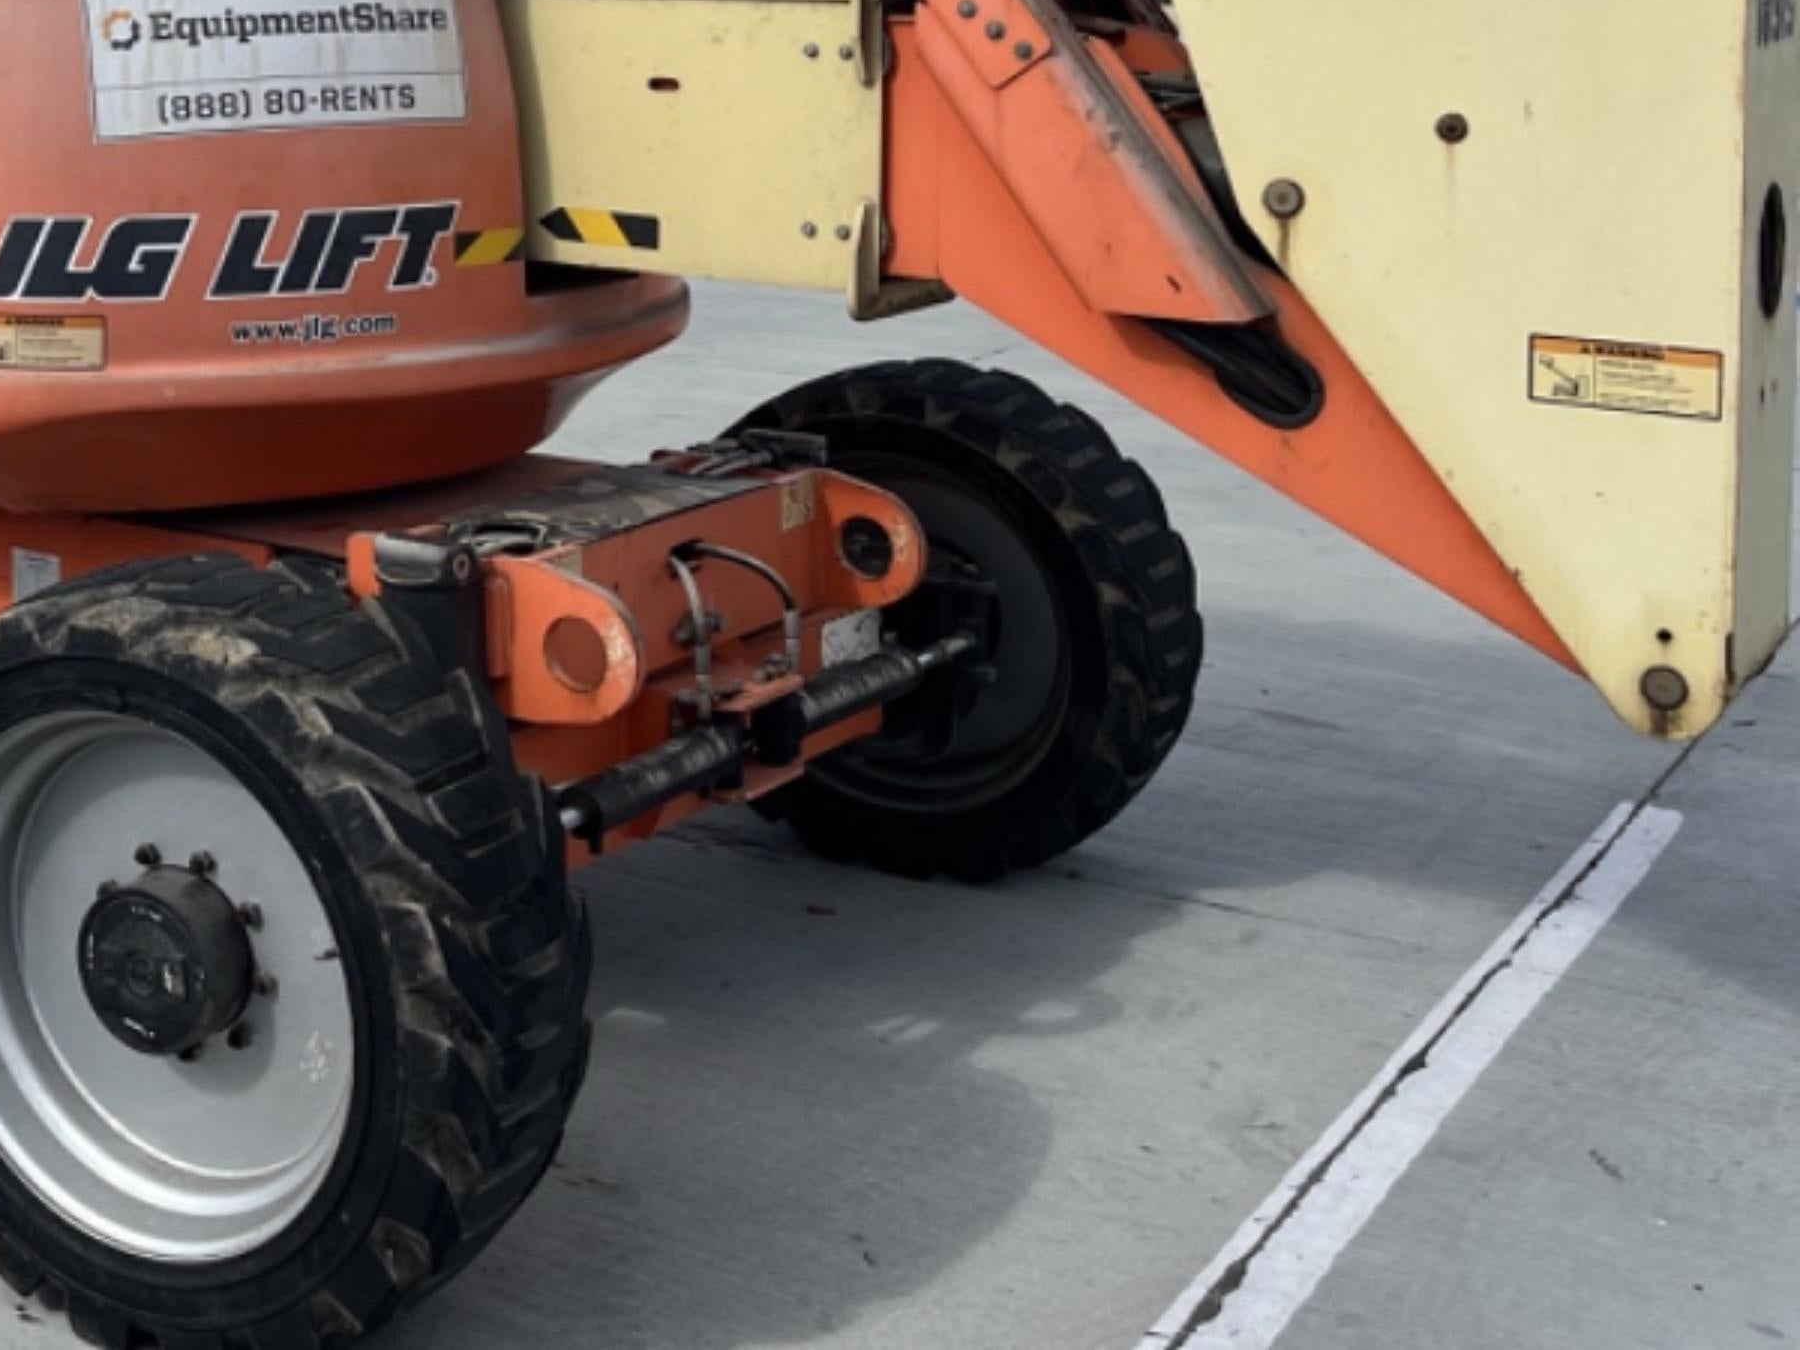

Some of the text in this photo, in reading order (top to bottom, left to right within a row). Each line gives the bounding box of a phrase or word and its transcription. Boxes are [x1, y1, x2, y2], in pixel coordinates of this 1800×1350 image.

[148, 2, 448, 47] EquipmentShare
[157, 83, 417, 125] (888) 80-RENTS
[206, 202, 460, 299] LIFT
[230, 312, 397, 343] www.jlg.com
